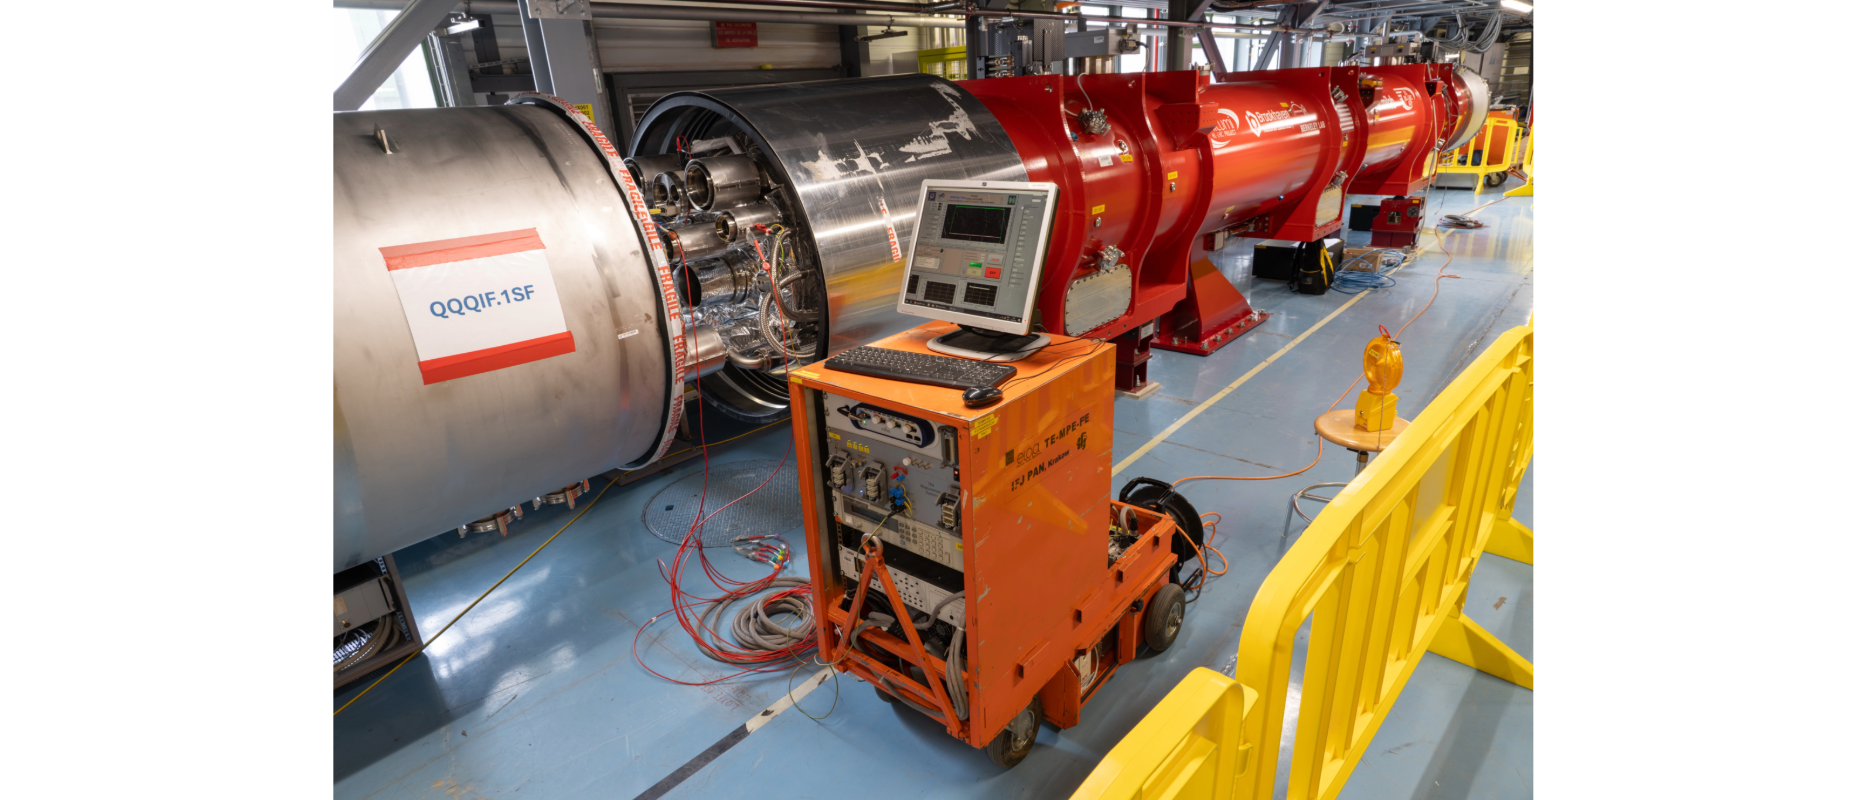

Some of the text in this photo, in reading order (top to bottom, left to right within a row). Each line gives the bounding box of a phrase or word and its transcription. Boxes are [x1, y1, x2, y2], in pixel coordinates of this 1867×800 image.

[1255, 110, 1291, 123] Brookhaven
[1318, 121, 1326, 129] LAB
[429, 284, 535, 319] QQQIF.1SF
[658, 265, 681, 322] FRAGILE
[672, 334, 686, 386] FRAGILE
